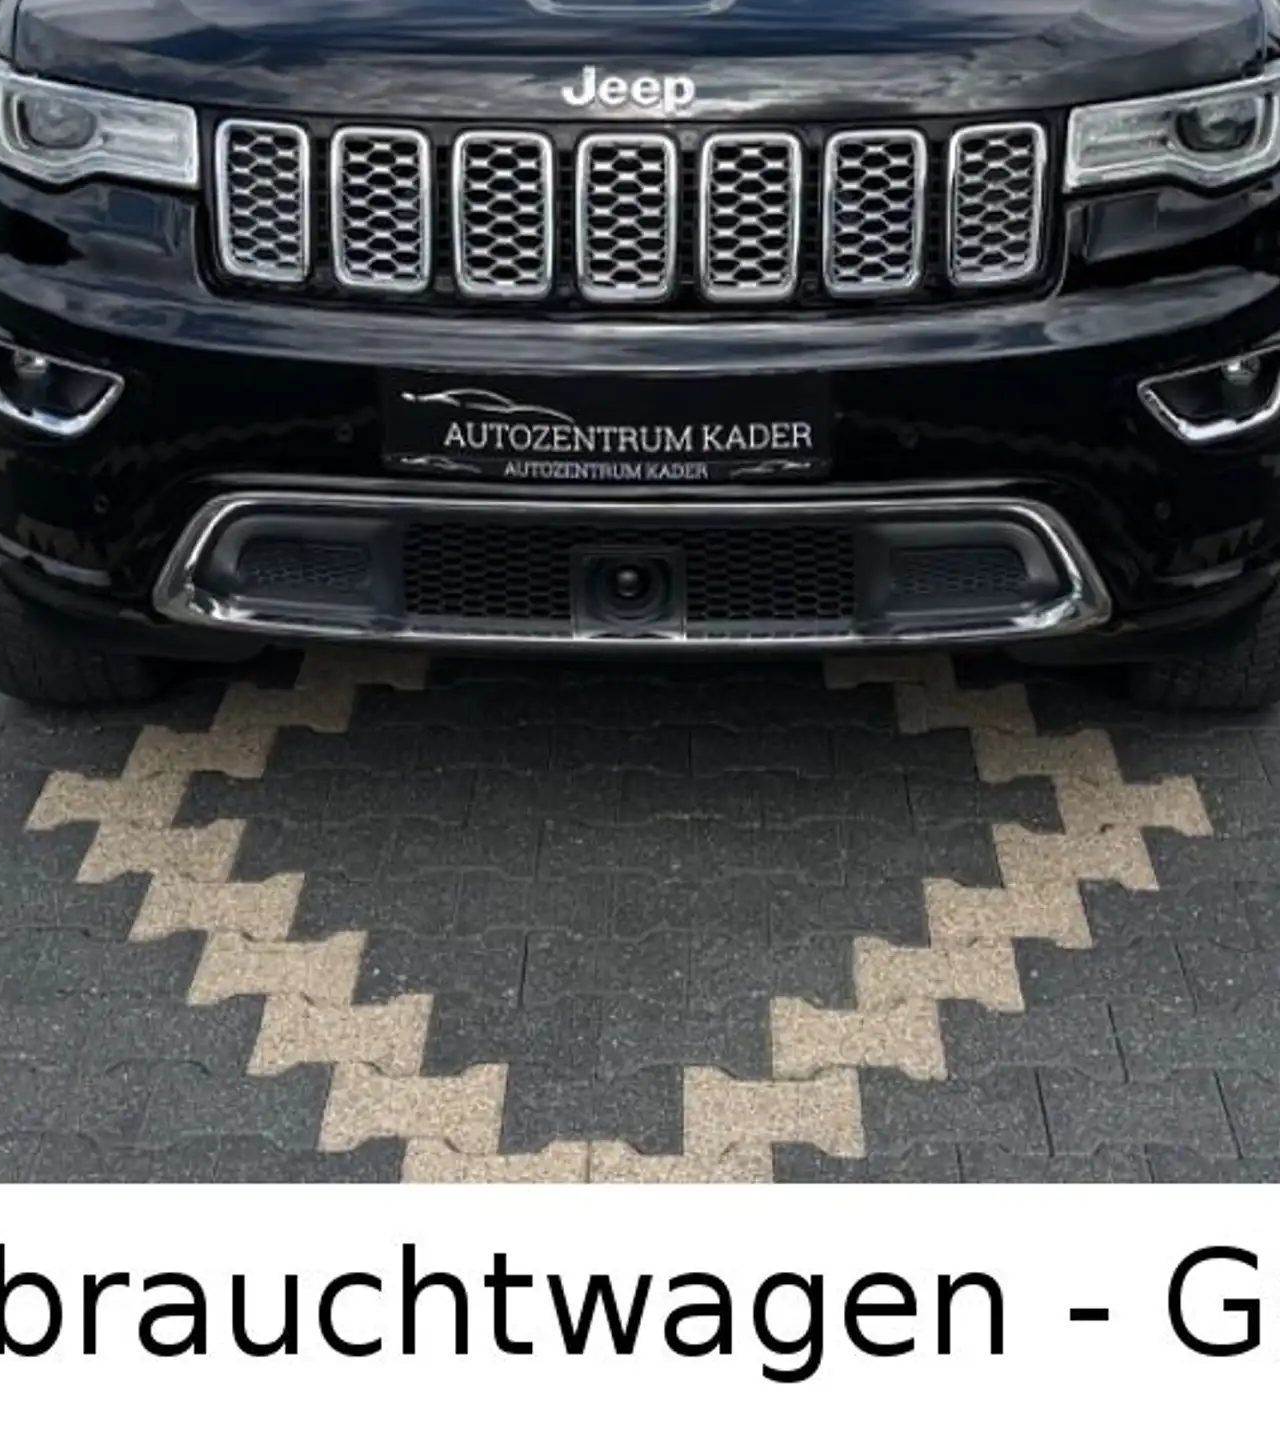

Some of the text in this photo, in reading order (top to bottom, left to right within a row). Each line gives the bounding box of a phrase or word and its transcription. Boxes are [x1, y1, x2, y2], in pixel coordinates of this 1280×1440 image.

[561, 64, 696, 114] Jeep
[443, 421, 814, 453] AUTOZENTRUM KADER
[503, 461, 710, 480] AUTOZENTRUM KADER
